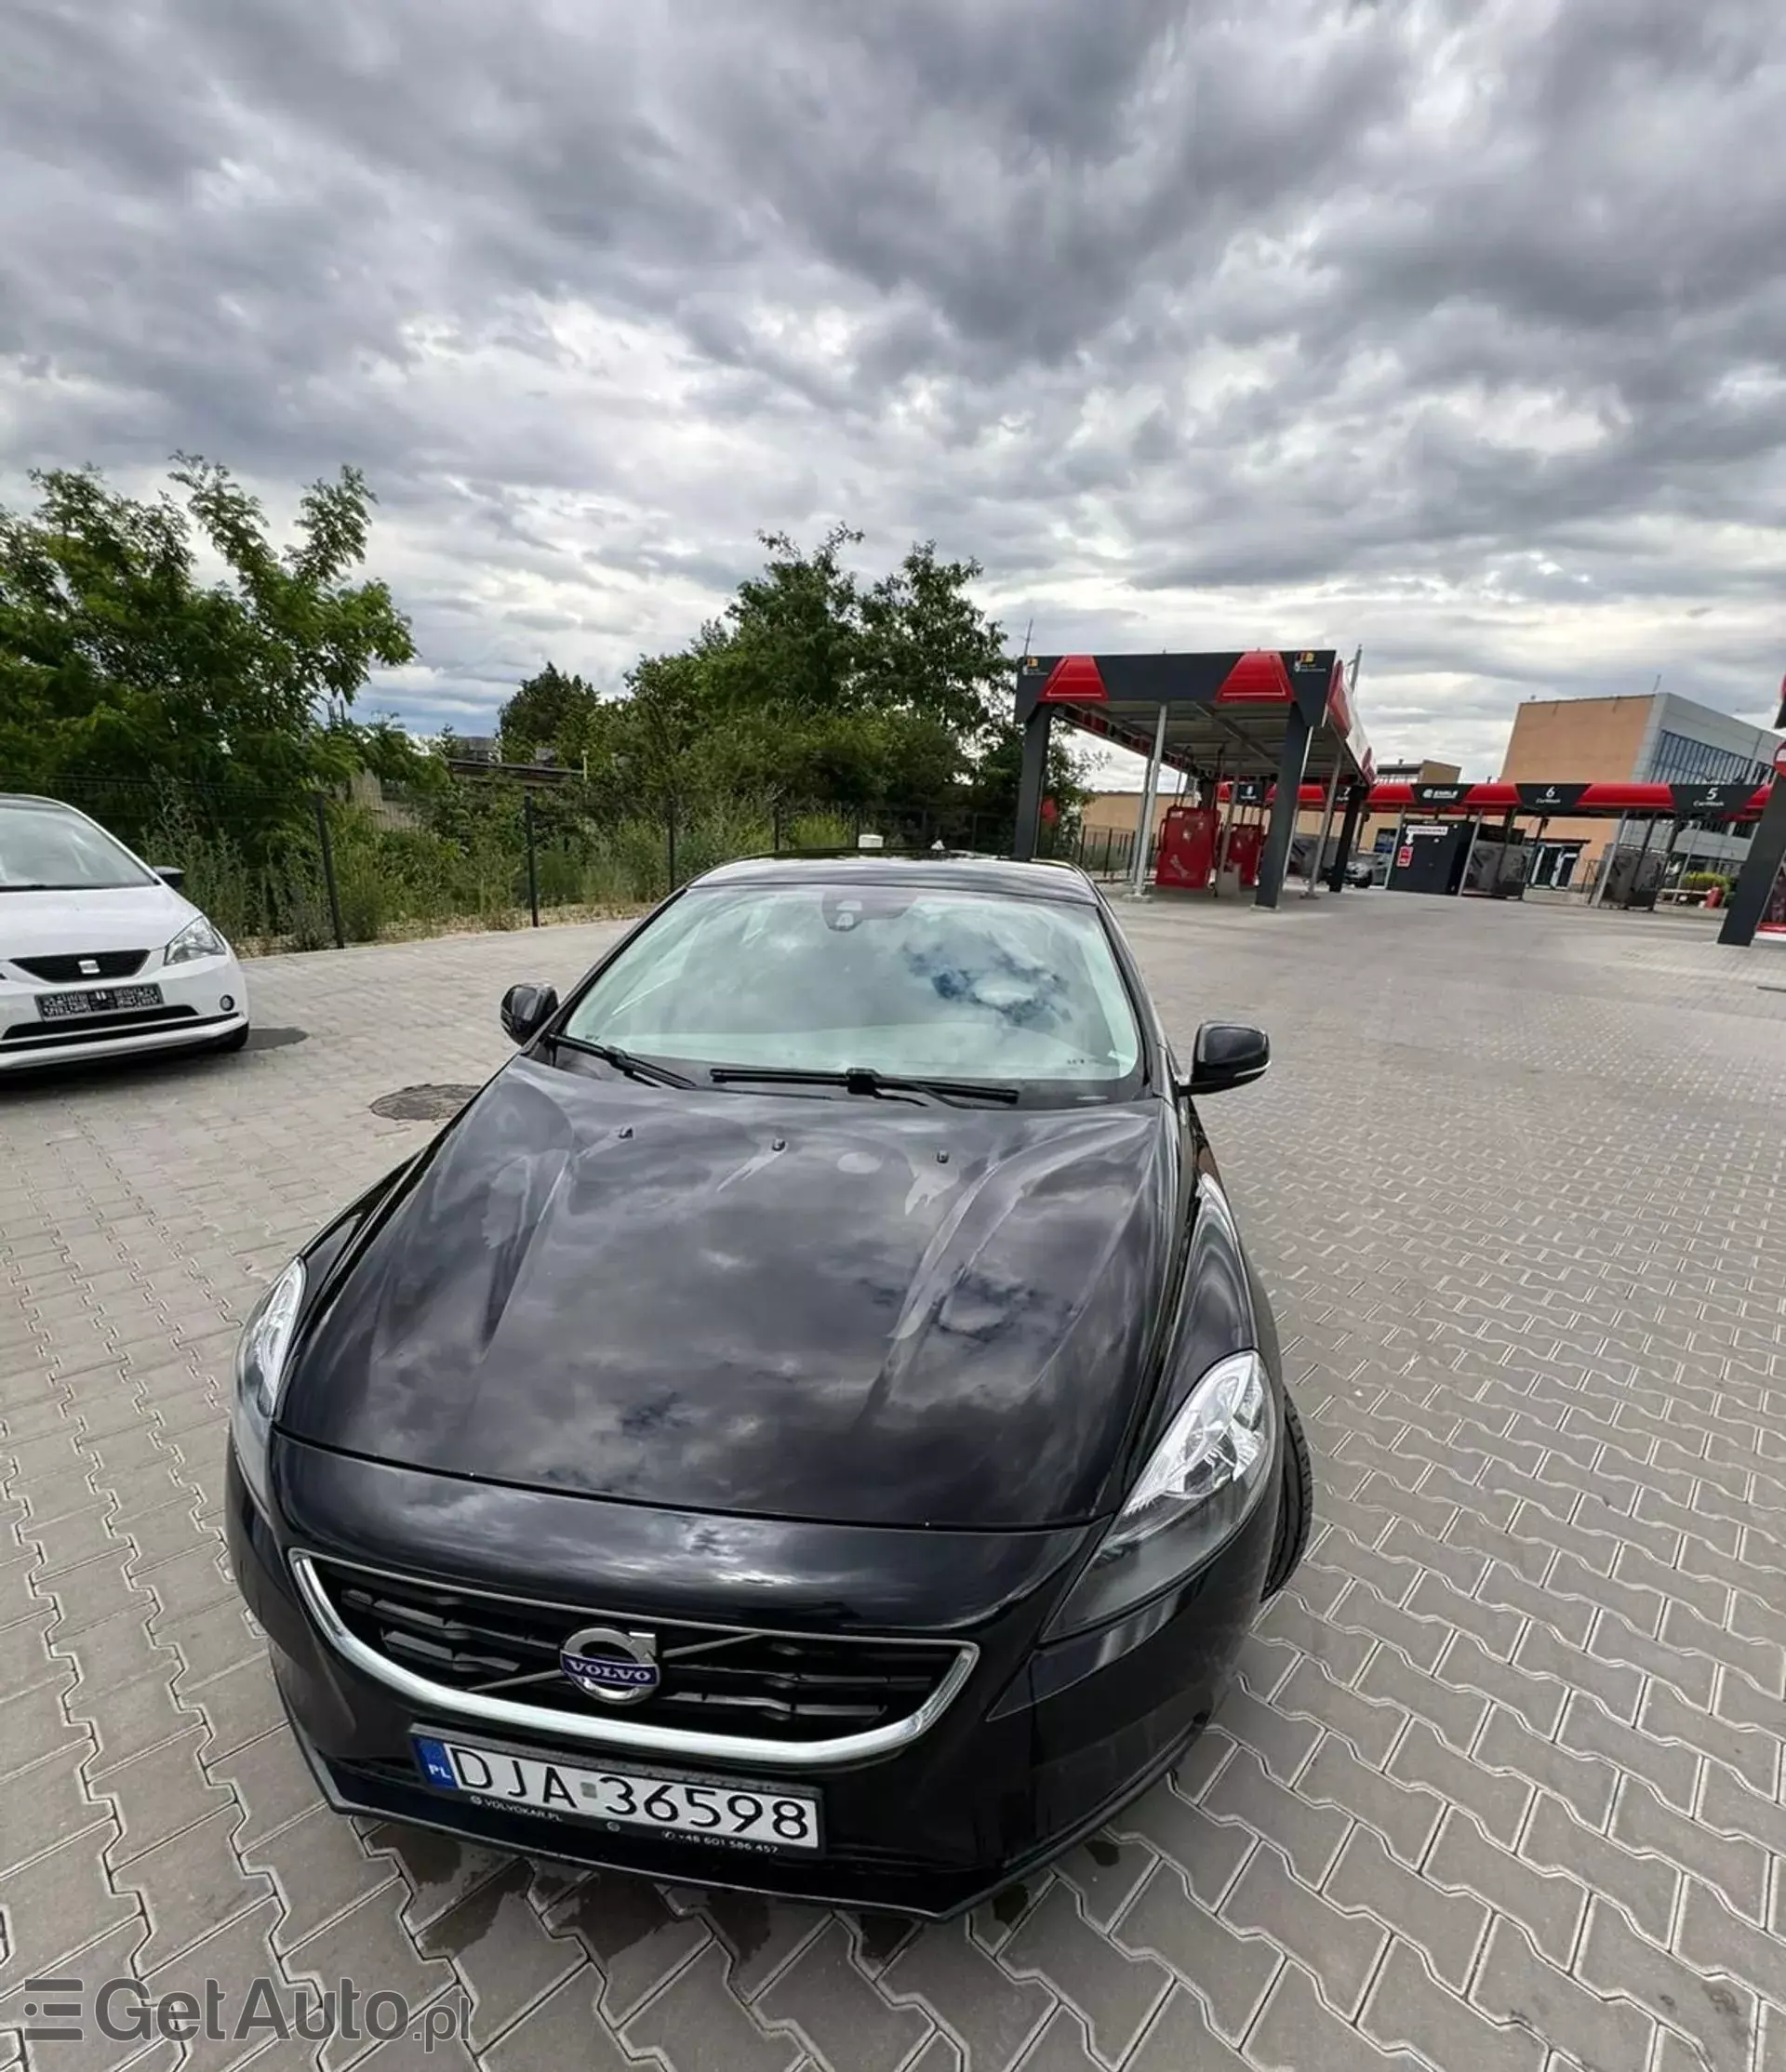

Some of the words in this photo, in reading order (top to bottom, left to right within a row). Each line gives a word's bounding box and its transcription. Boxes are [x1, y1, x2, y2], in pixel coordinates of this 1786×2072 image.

[1546, 785, 1555, 798] 6
[1706, 787, 1719, 800] 5
[566, 1658, 651, 1681] VOLVO
[428, 1763, 452, 1779] PL
[449, 1747, 579, 1809] DJA
[598, 1775, 808, 1840] 36598
[678, 1833, 700, 1843] +48
[703, 1836, 726, 1847] 601
[728, 1840, 753, 1850] 586
[754, 1843, 779, 1853] 457
